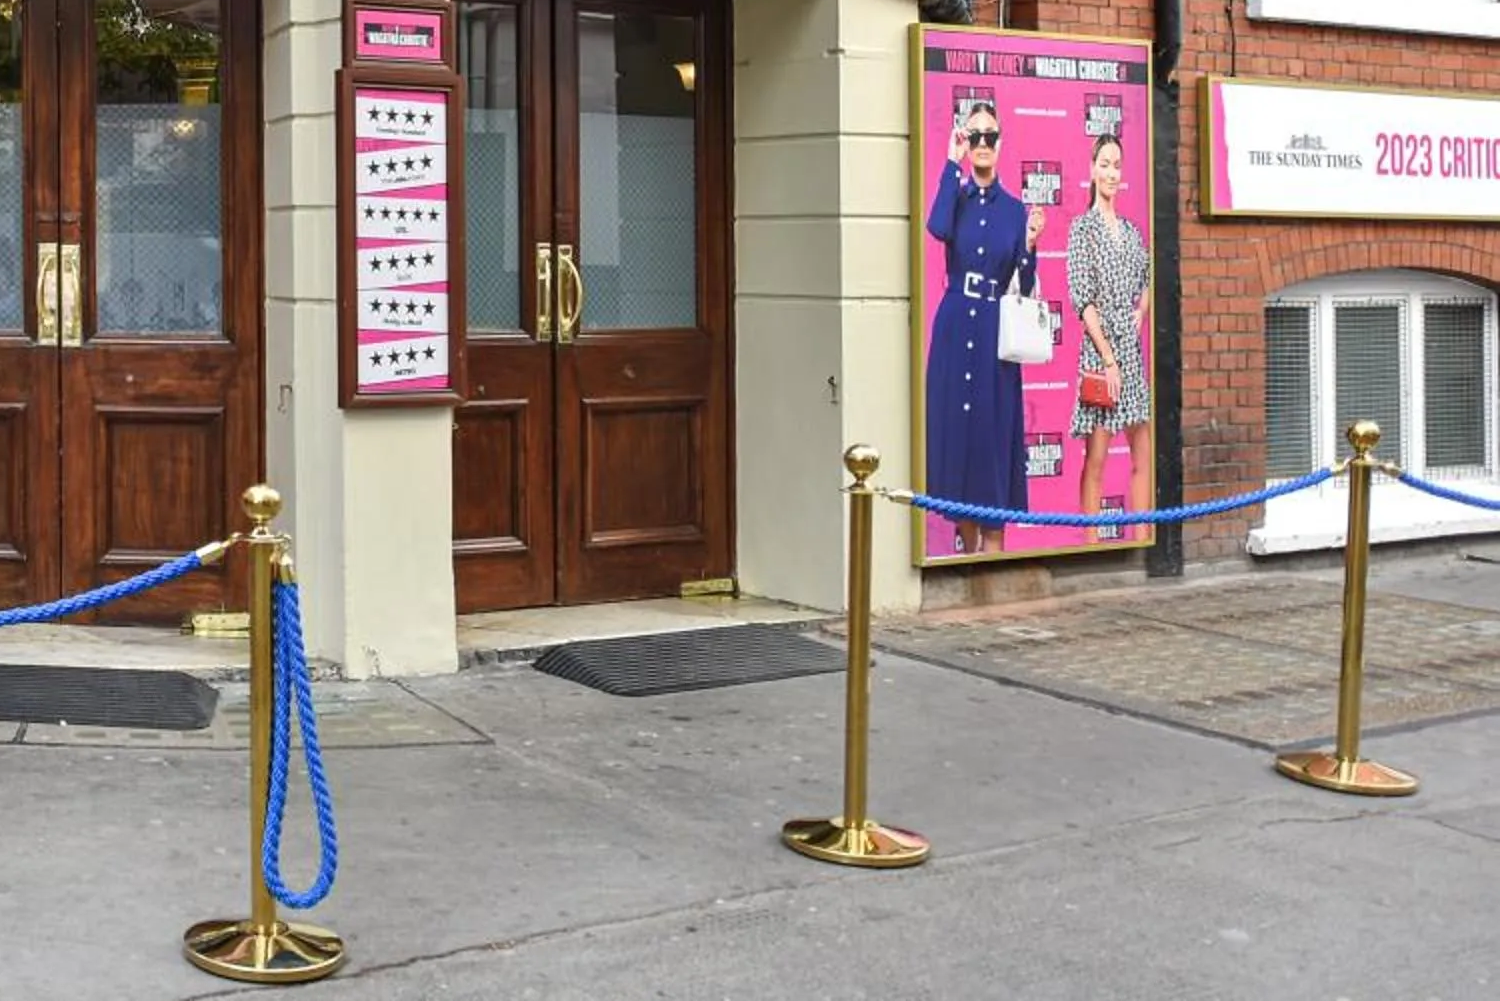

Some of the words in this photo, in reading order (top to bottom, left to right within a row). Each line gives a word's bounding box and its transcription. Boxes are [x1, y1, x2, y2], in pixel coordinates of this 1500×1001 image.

[1248, 150, 1273, 166] THE
[1276, 151, 1325, 168] SUNDAY
[1325, 153, 1363, 170] TIMES
[1375, 132, 1433, 178] 2023
